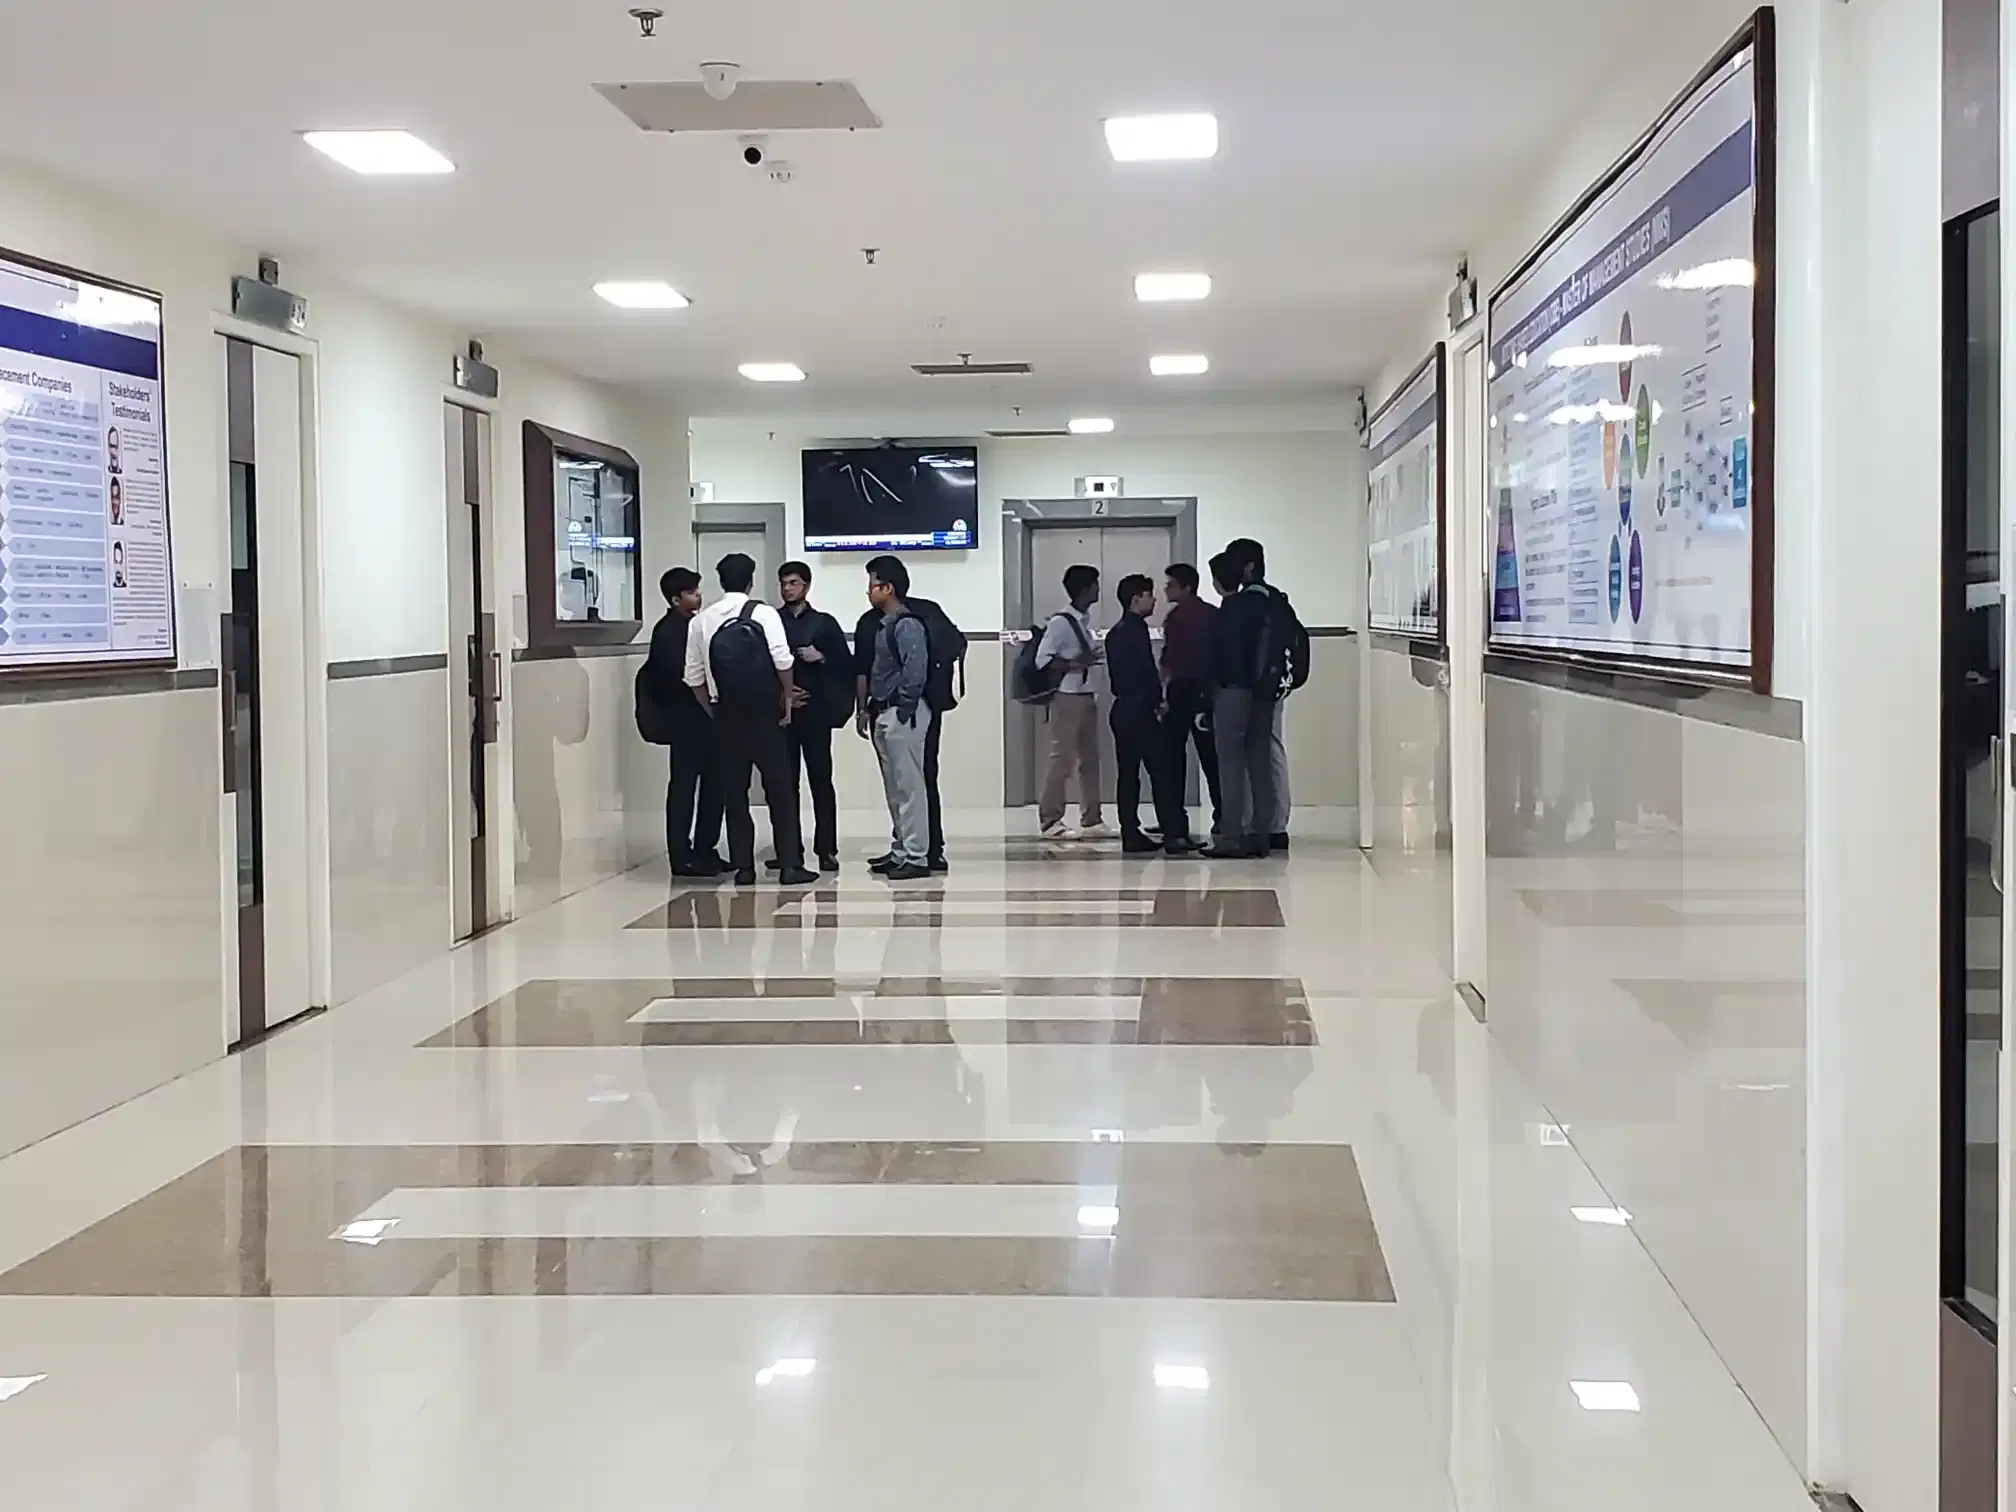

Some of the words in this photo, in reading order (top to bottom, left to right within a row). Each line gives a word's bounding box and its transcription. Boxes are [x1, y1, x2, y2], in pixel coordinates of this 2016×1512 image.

[32, 372, 72, 394] Companies
[111, 402, 151, 423] Testimonials
[1095, 500, 1104, 515] 2
